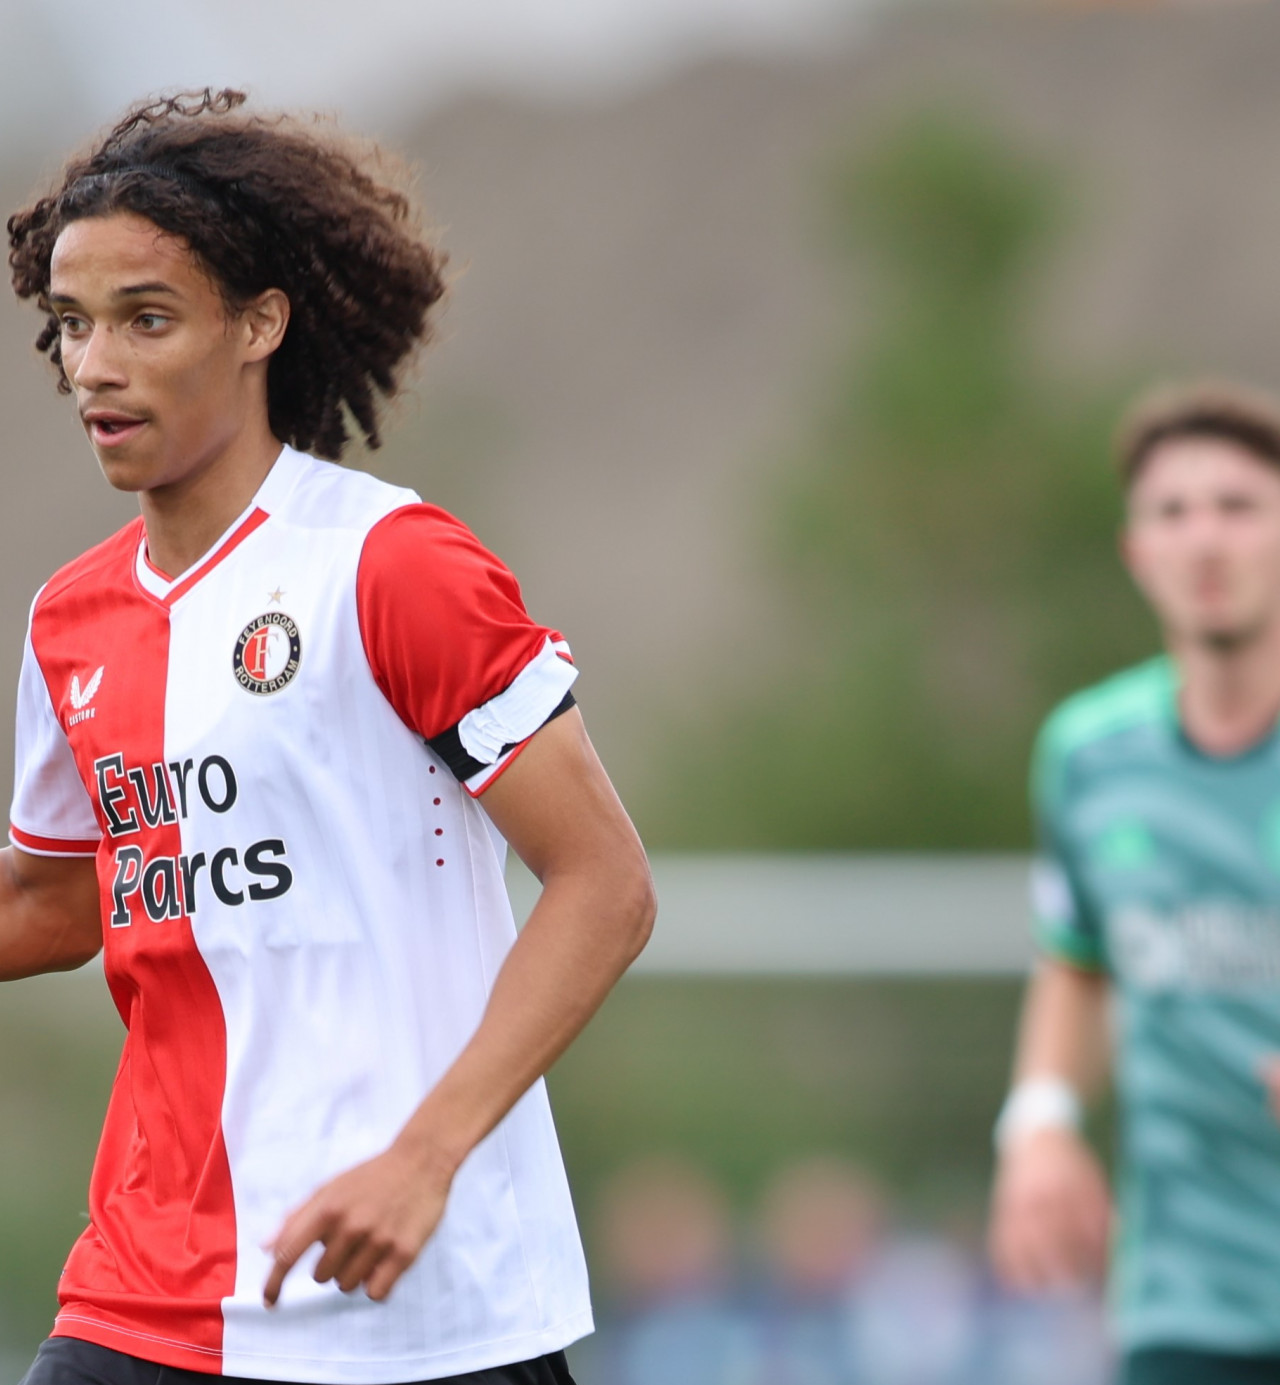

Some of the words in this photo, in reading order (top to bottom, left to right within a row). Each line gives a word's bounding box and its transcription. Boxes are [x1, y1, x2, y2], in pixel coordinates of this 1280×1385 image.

[239, 613, 298, 645] FEYENOORD
[235, 659, 299, 692] ROTTERDAM
[94, 752, 238, 838] Euro
[111, 838, 293, 928] Parcs
